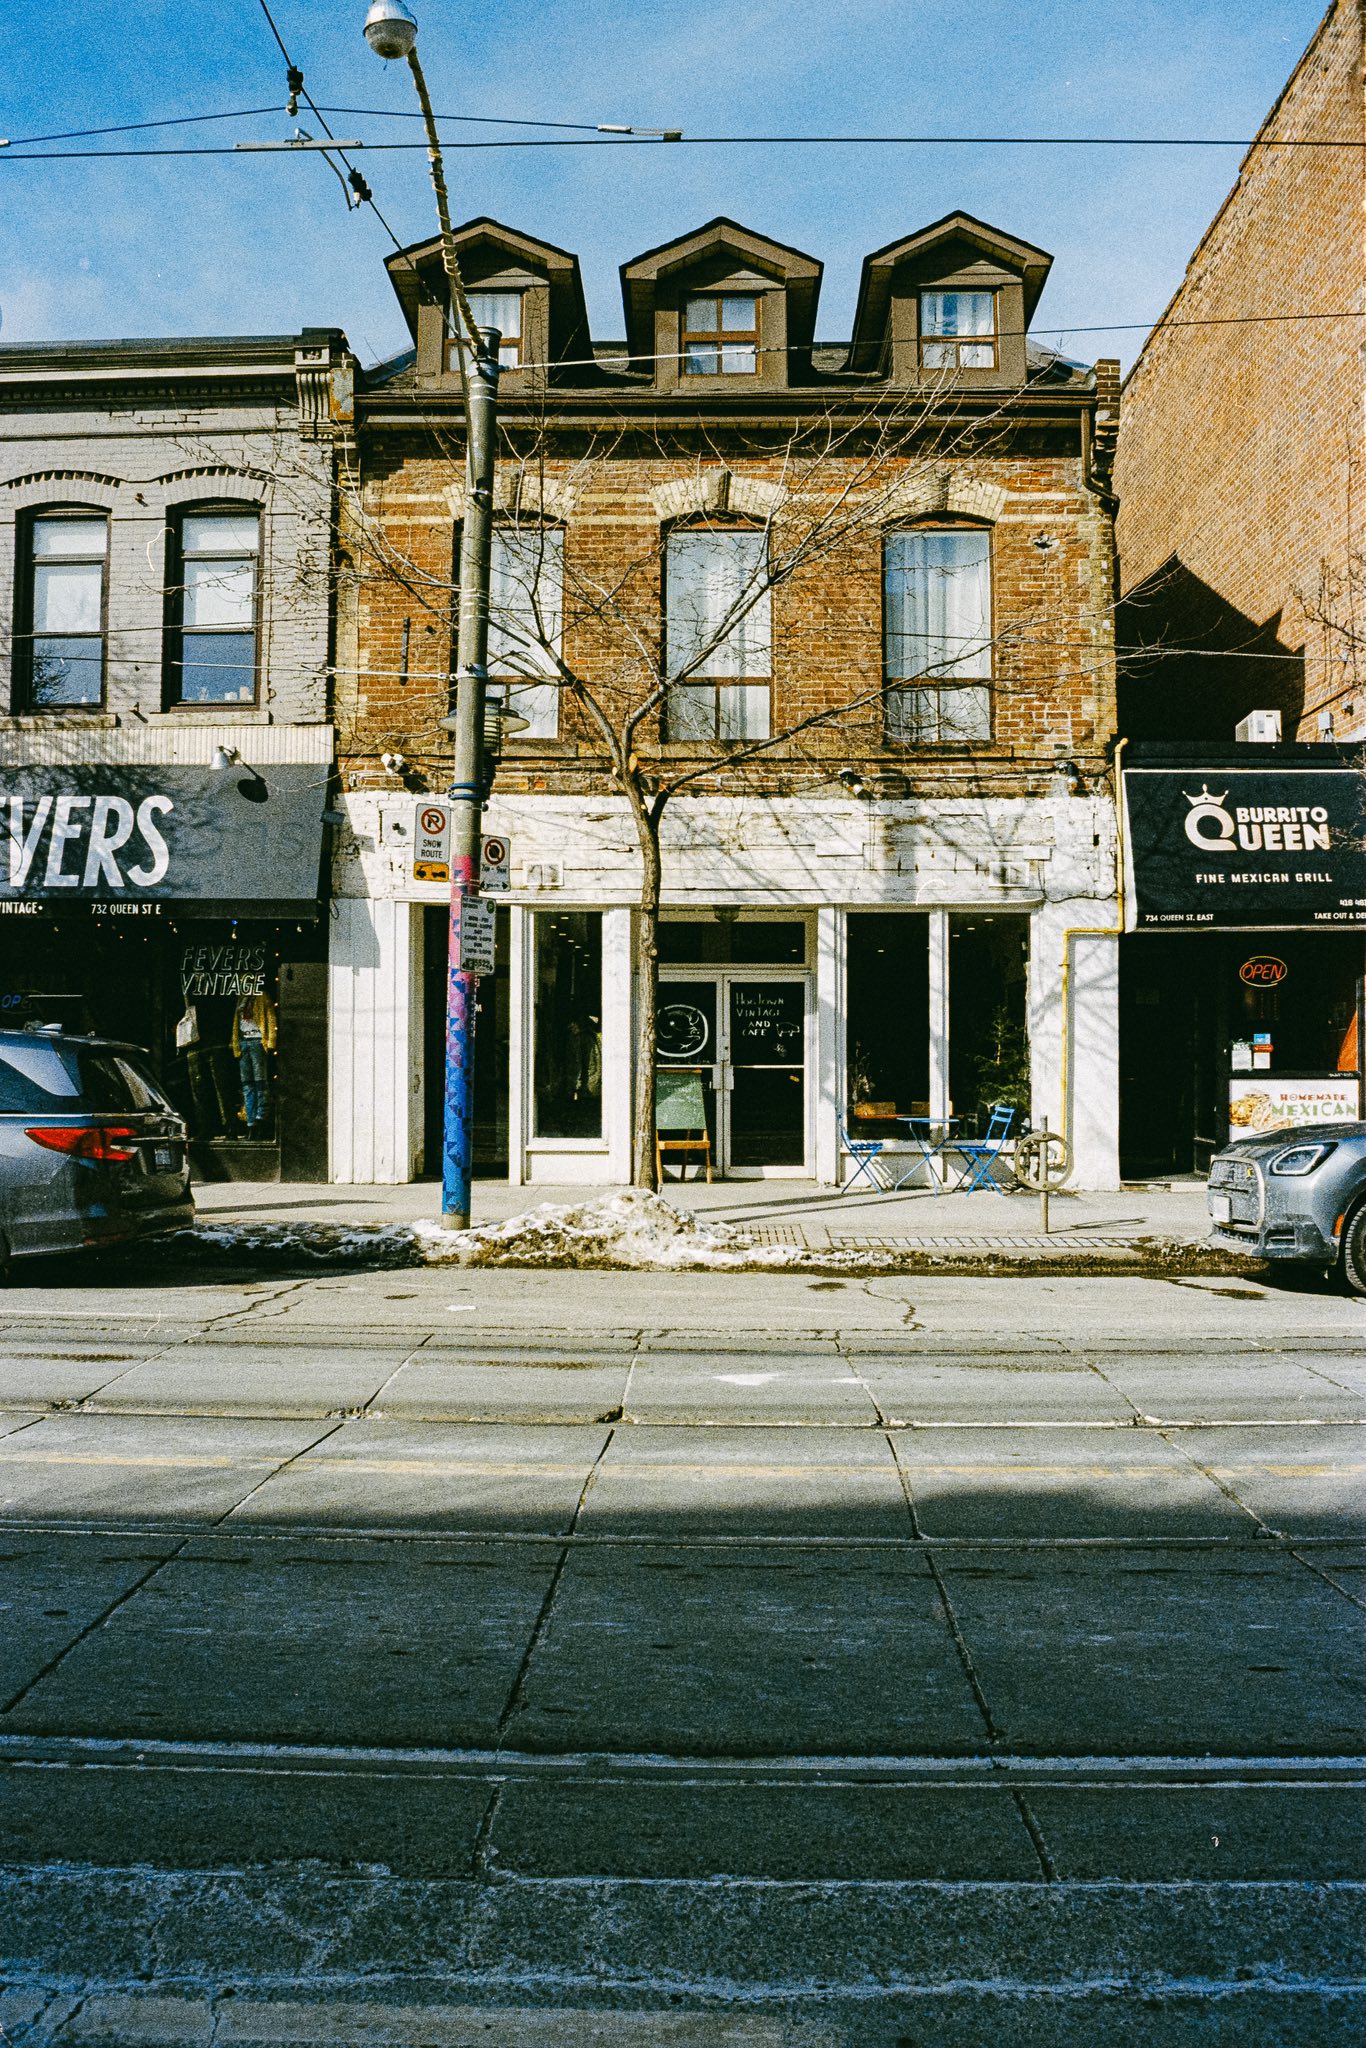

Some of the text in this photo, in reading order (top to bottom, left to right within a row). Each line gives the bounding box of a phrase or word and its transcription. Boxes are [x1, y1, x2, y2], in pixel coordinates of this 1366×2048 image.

[1236, 807, 1328, 823] BURRITO
[1184, 803, 1331, 851] QUEEN
[0, 795, 174, 887] VERS
[422, 839, 442, 848] SNOW
[421, 849, 443, 858] ROUTE
[1196, 873, 1333, 883] FINE MEXICAN GRILL
[0, 902, 38, 914] INTAGE
[91, 904, 162, 915] 732 QUEEN ST E
[1197, 913, 1214, 921] EAST
[180, 946, 266, 971] FEVERS
[1242, 963, 1284, 980] OPEN
[180, 972, 266, 996] VINTAGE
[748, 1020, 771, 1028] AND
[1271, 1102, 1357, 1116] MEXICAN
